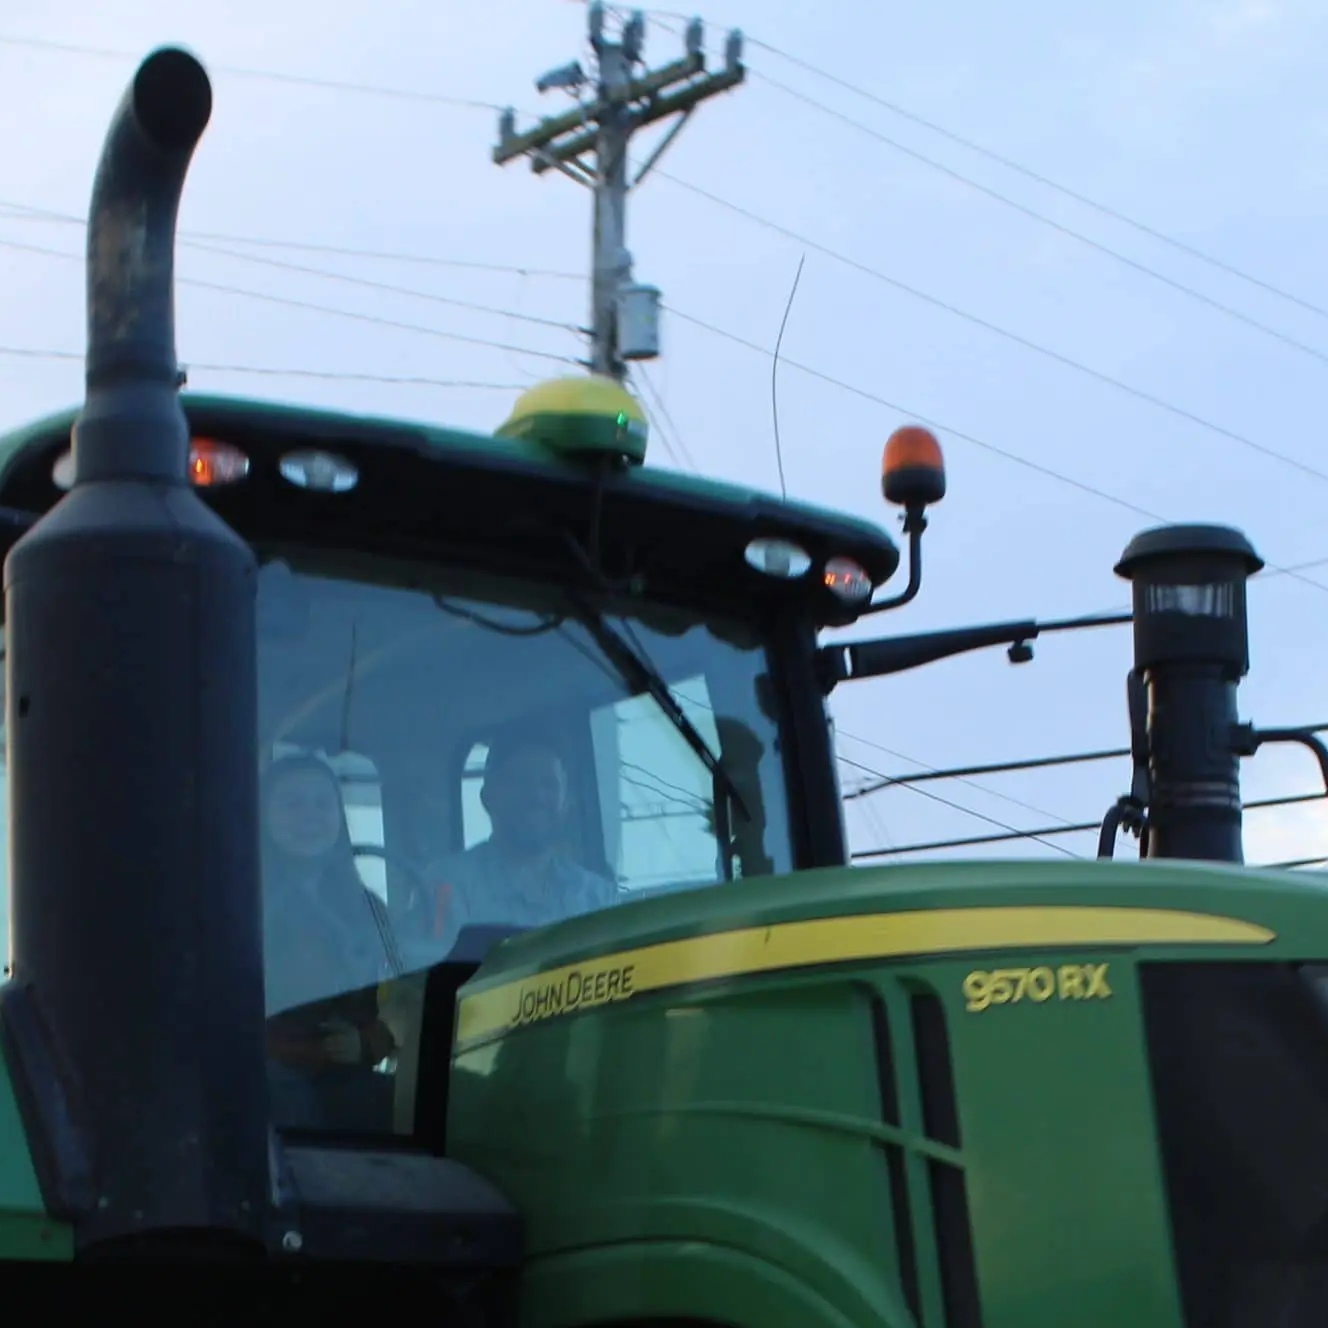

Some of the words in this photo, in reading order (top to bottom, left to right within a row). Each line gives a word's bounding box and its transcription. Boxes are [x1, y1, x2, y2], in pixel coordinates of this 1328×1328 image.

[512, 980, 564, 1023] JOHN
[566, 966, 635, 1005] DEERE
[962, 966, 1056, 1013] 9570
[1057, 963, 1113, 1001] RX
